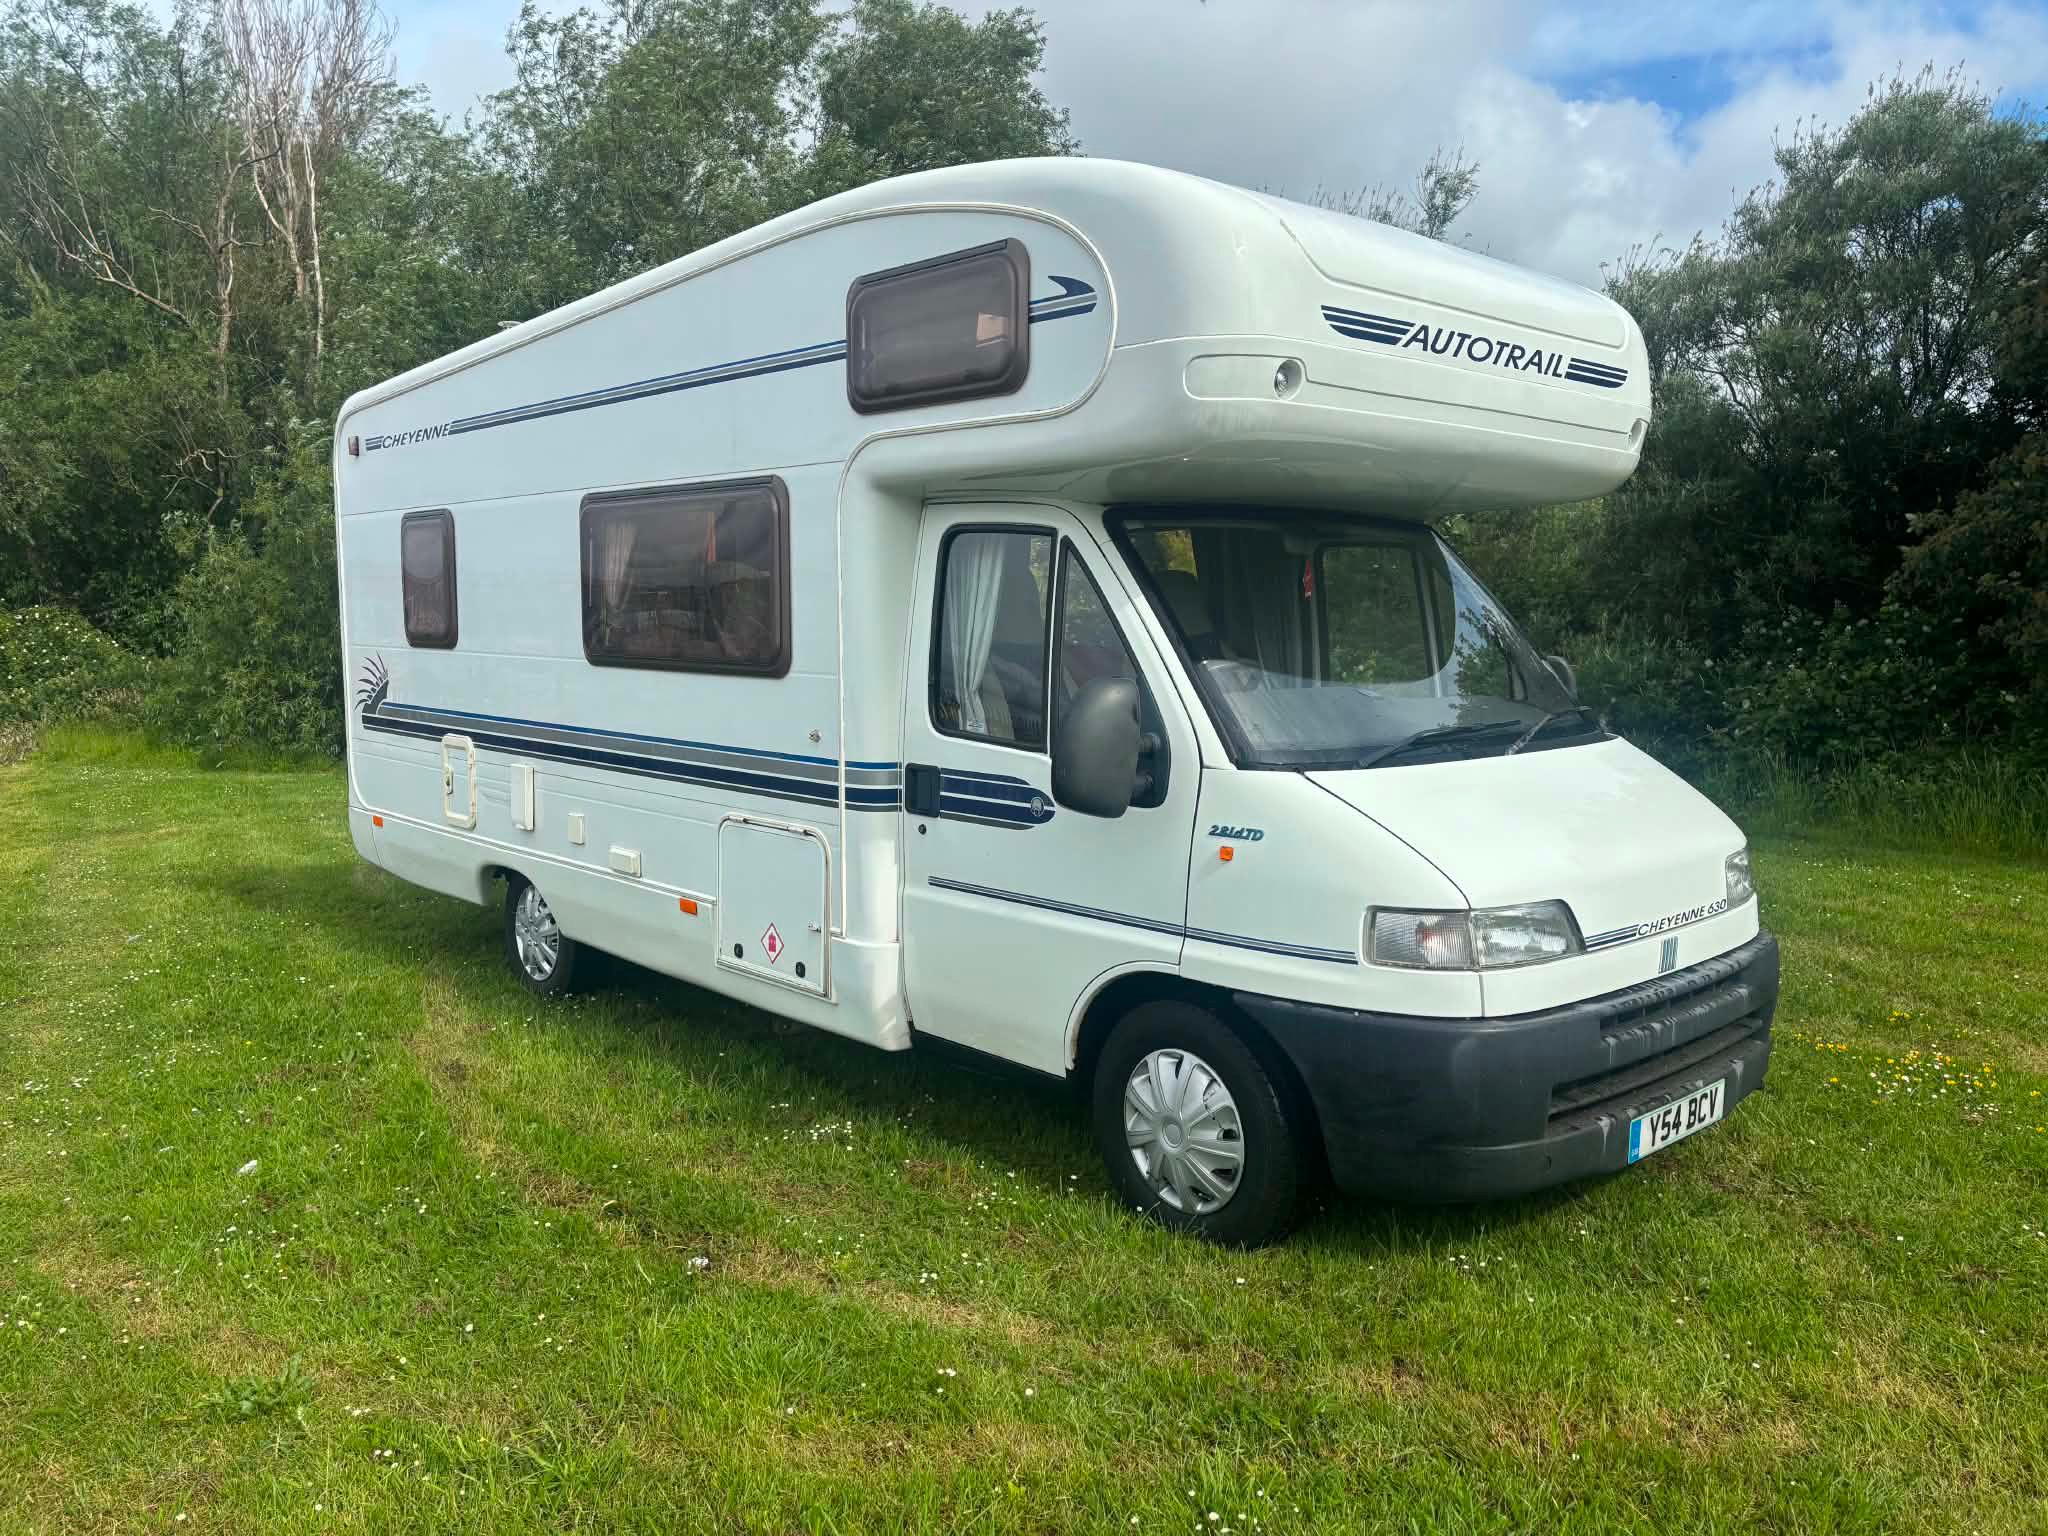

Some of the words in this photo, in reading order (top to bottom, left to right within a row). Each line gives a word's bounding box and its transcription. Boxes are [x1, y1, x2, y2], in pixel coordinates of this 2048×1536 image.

[1401, 325, 1564, 378] AUTOTRAIL
[382, 423, 450, 448] CHEYENNE
[1637, 906, 1705, 936] CHEYENNE
[1707, 899, 1727, 914] 630
[1650, 1104, 1682, 1147] Y54
[1686, 1087, 1719, 1130] BCV
